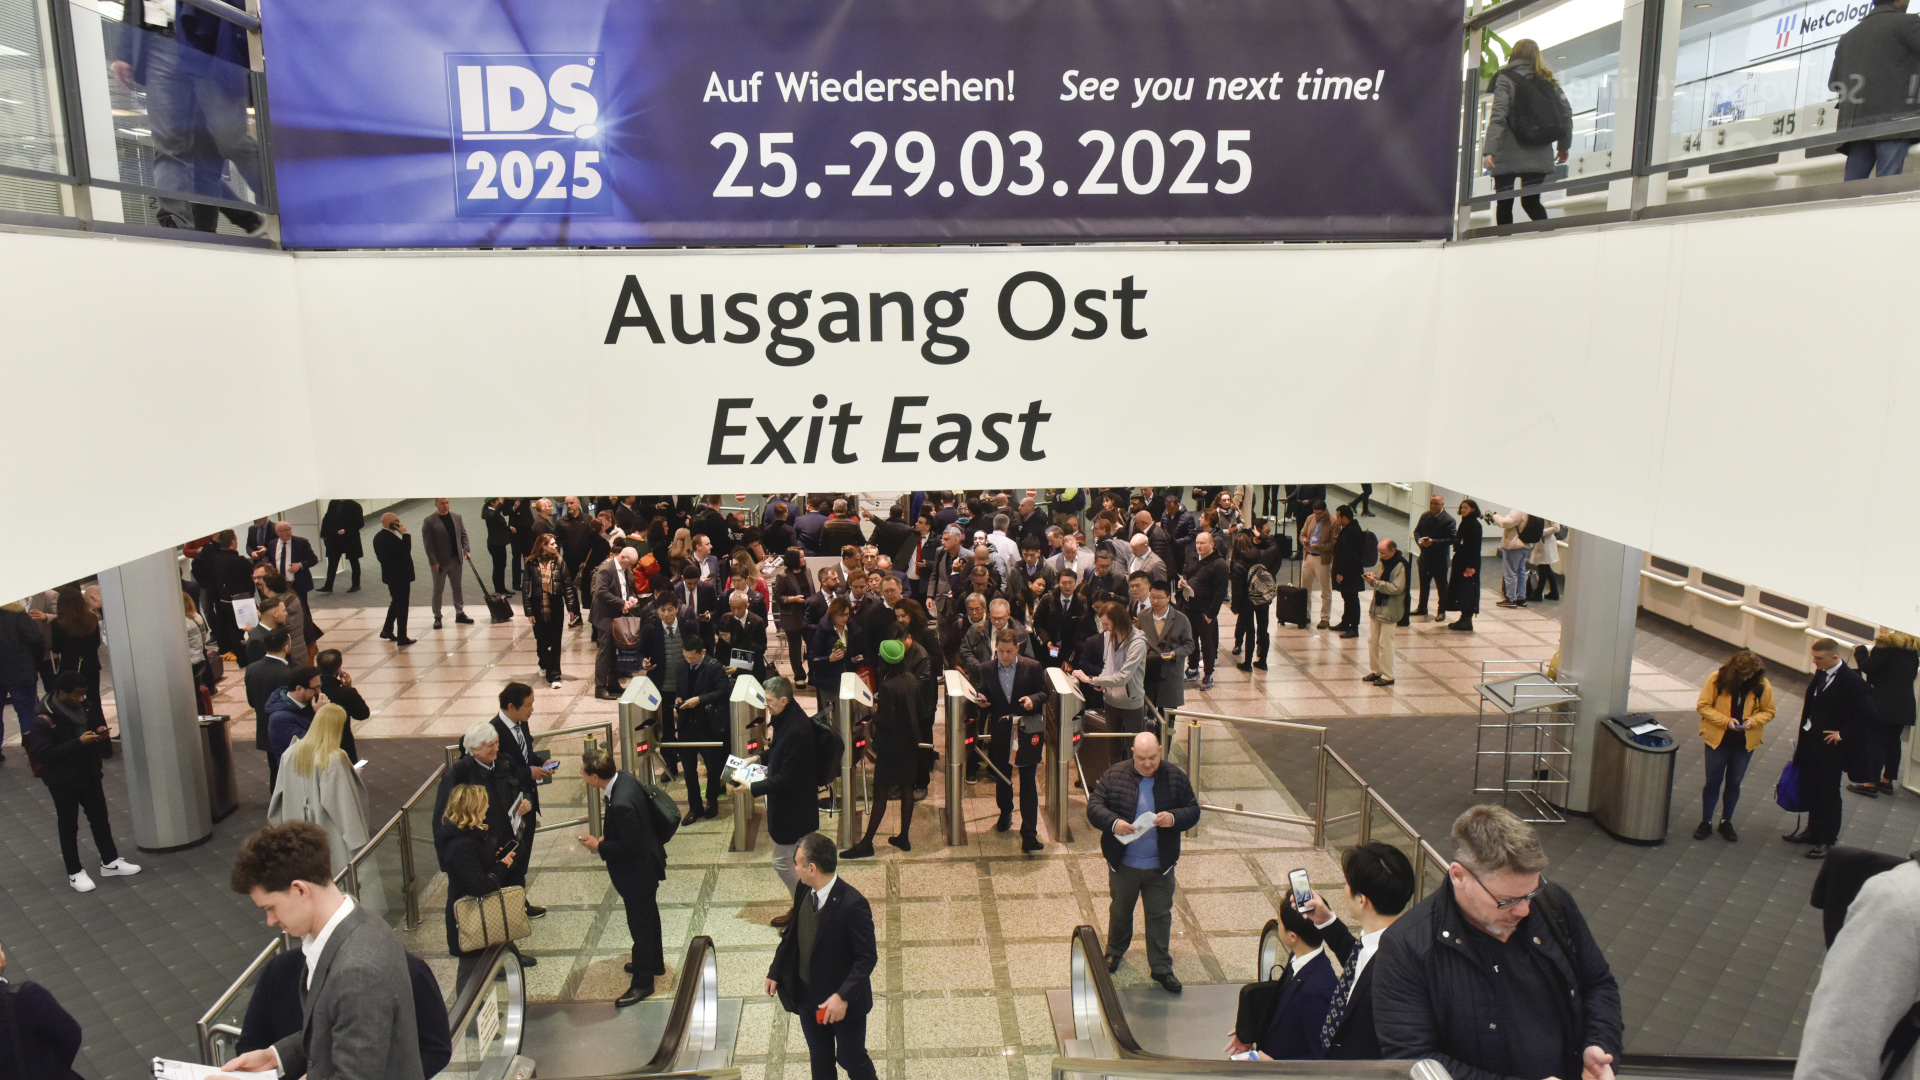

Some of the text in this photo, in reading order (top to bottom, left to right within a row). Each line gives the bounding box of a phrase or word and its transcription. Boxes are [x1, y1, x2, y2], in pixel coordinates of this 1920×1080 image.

[457, 64, 599, 133] IDS
[703, 68, 1385, 108] Auf Wiedersehen! See you next time!
[466, 150, 602, 199] 2025
[711, 130, 1252, 198] 25.-29.03.2025
[604, 271, 1148, 366] Ausgang Ost
[708, 394, 1052, 465] Exit East
